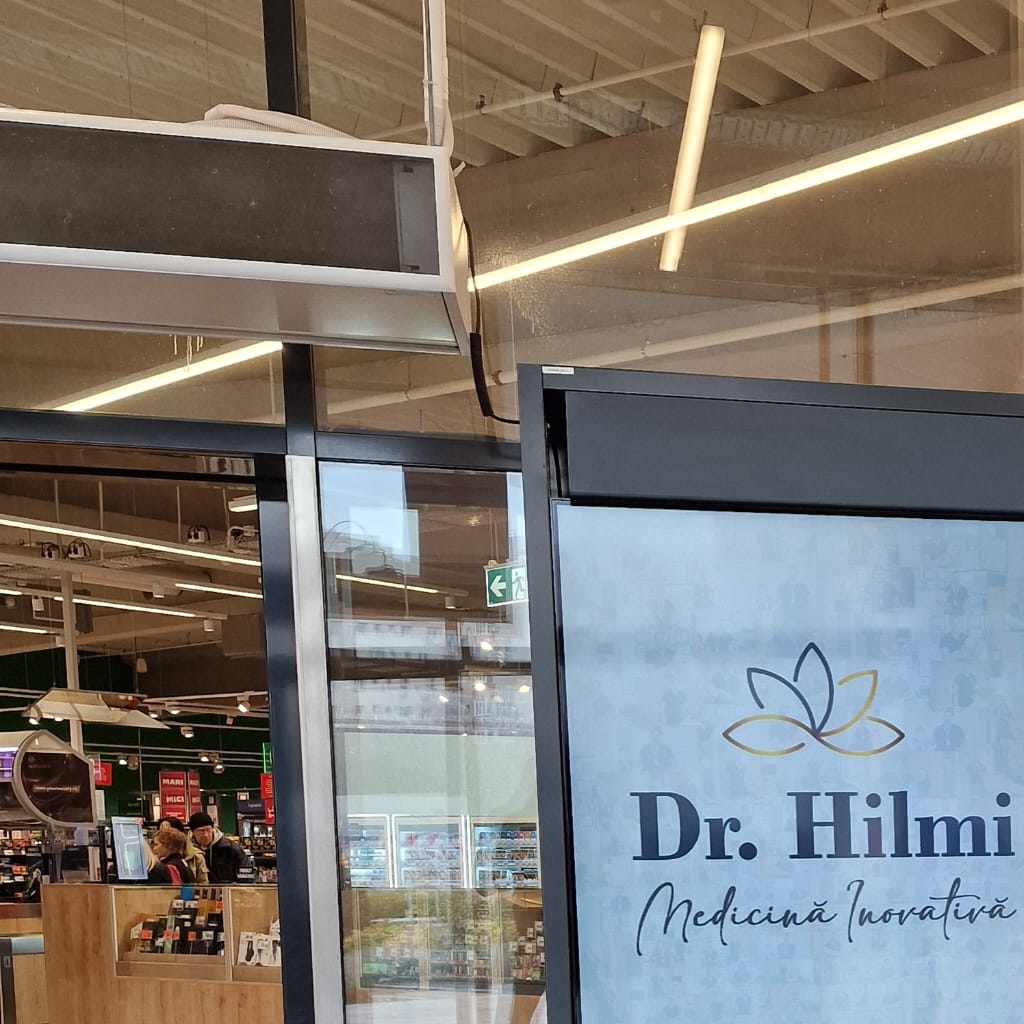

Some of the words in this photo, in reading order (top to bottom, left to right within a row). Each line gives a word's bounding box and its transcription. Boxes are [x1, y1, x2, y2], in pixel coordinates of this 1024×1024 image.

[162, 778, 184, 786] MARI
[165, 795, 185, 803] MICI
[630, 791, 758, 861] Dr.
[786, 790, 1016, 859] Hilmi
[636, 881, 838, 957] Medicină
[846, 877, 1017, 944] Inovativă
